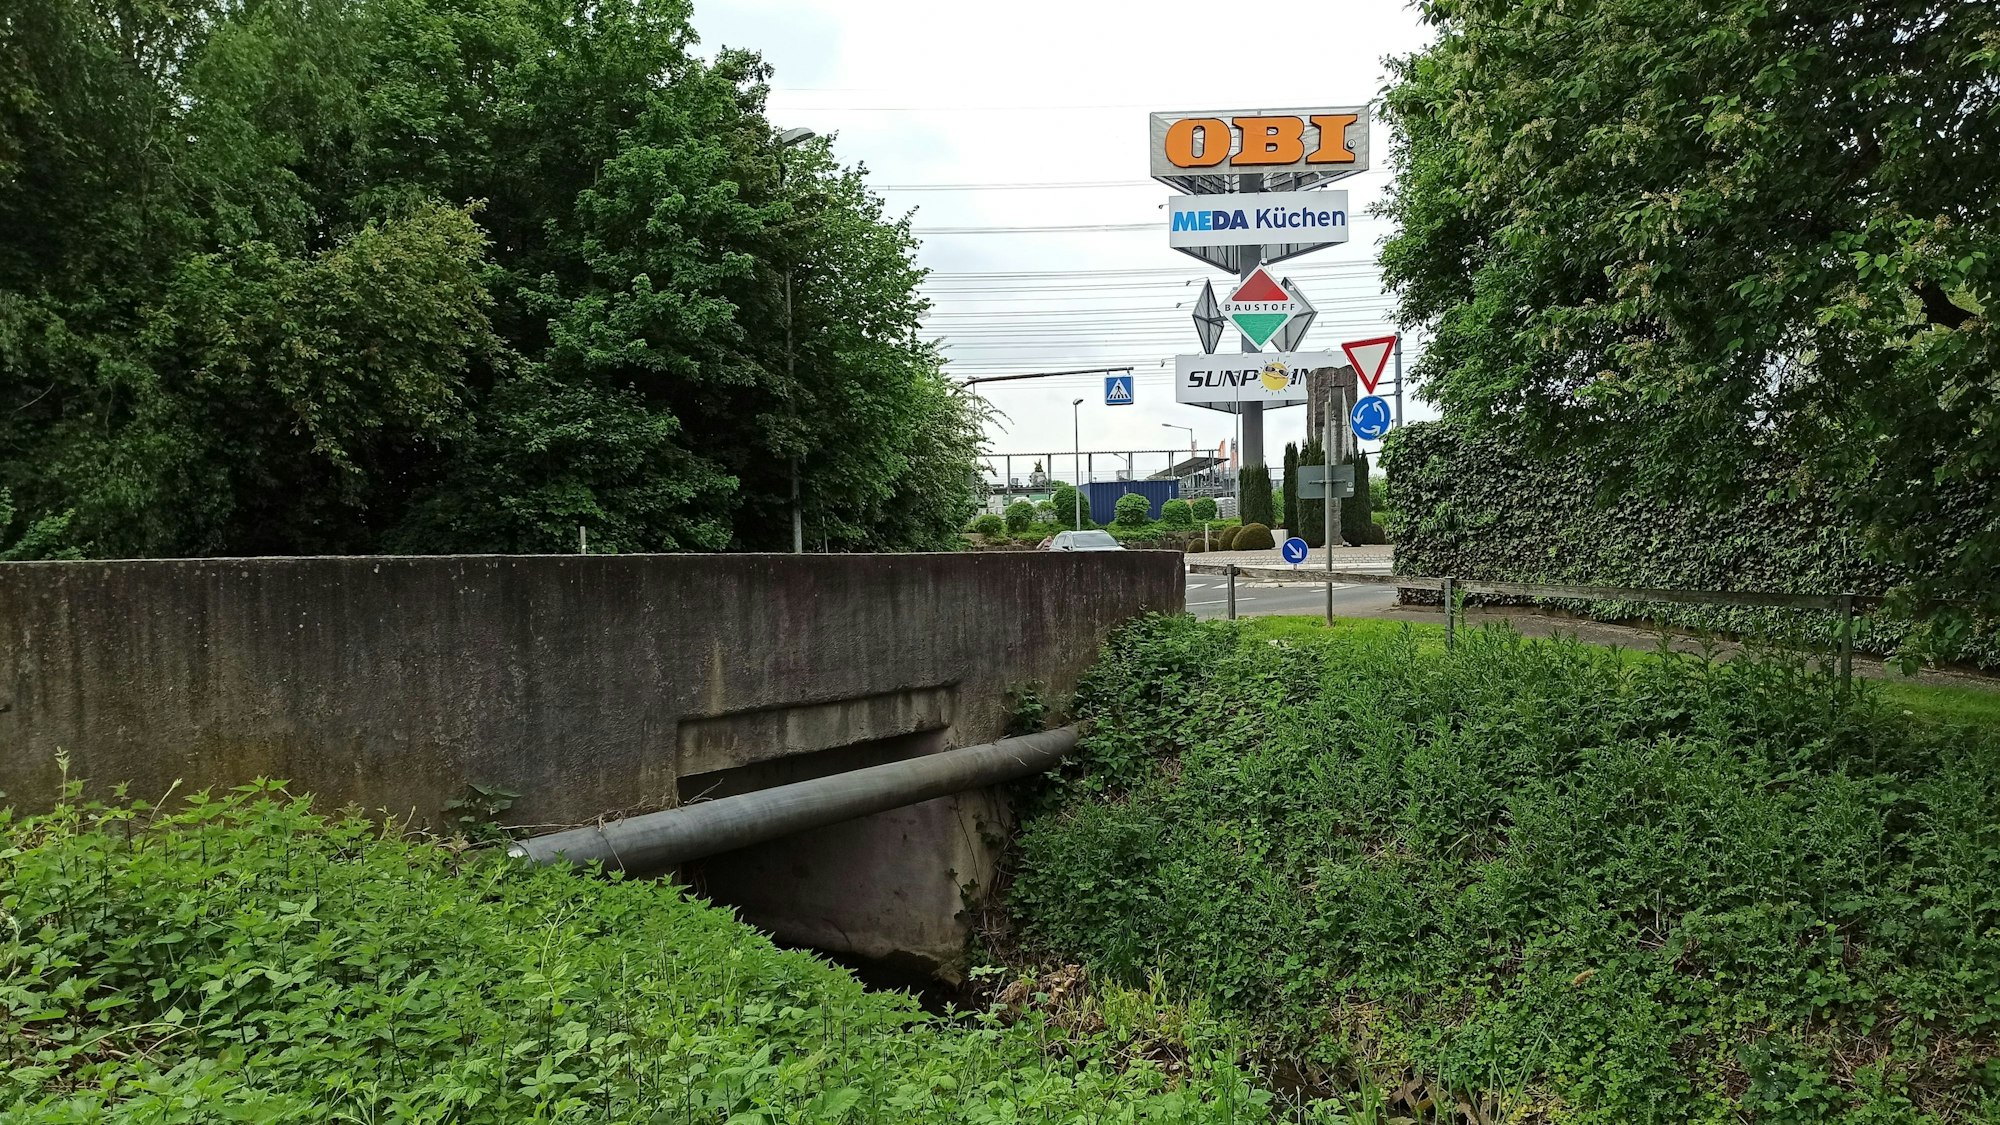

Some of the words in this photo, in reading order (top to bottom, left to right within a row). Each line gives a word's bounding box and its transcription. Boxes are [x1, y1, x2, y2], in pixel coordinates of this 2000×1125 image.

[1165, 114, 1358, 168] OBI
[1172, 209, 1250, 232] MEDA
[1256, 207, 1346, 230] Küchen
[1224, 303, 1296, 312] BAUSTOFF
[1187, 362, 1311, 390] SUNPOIN
